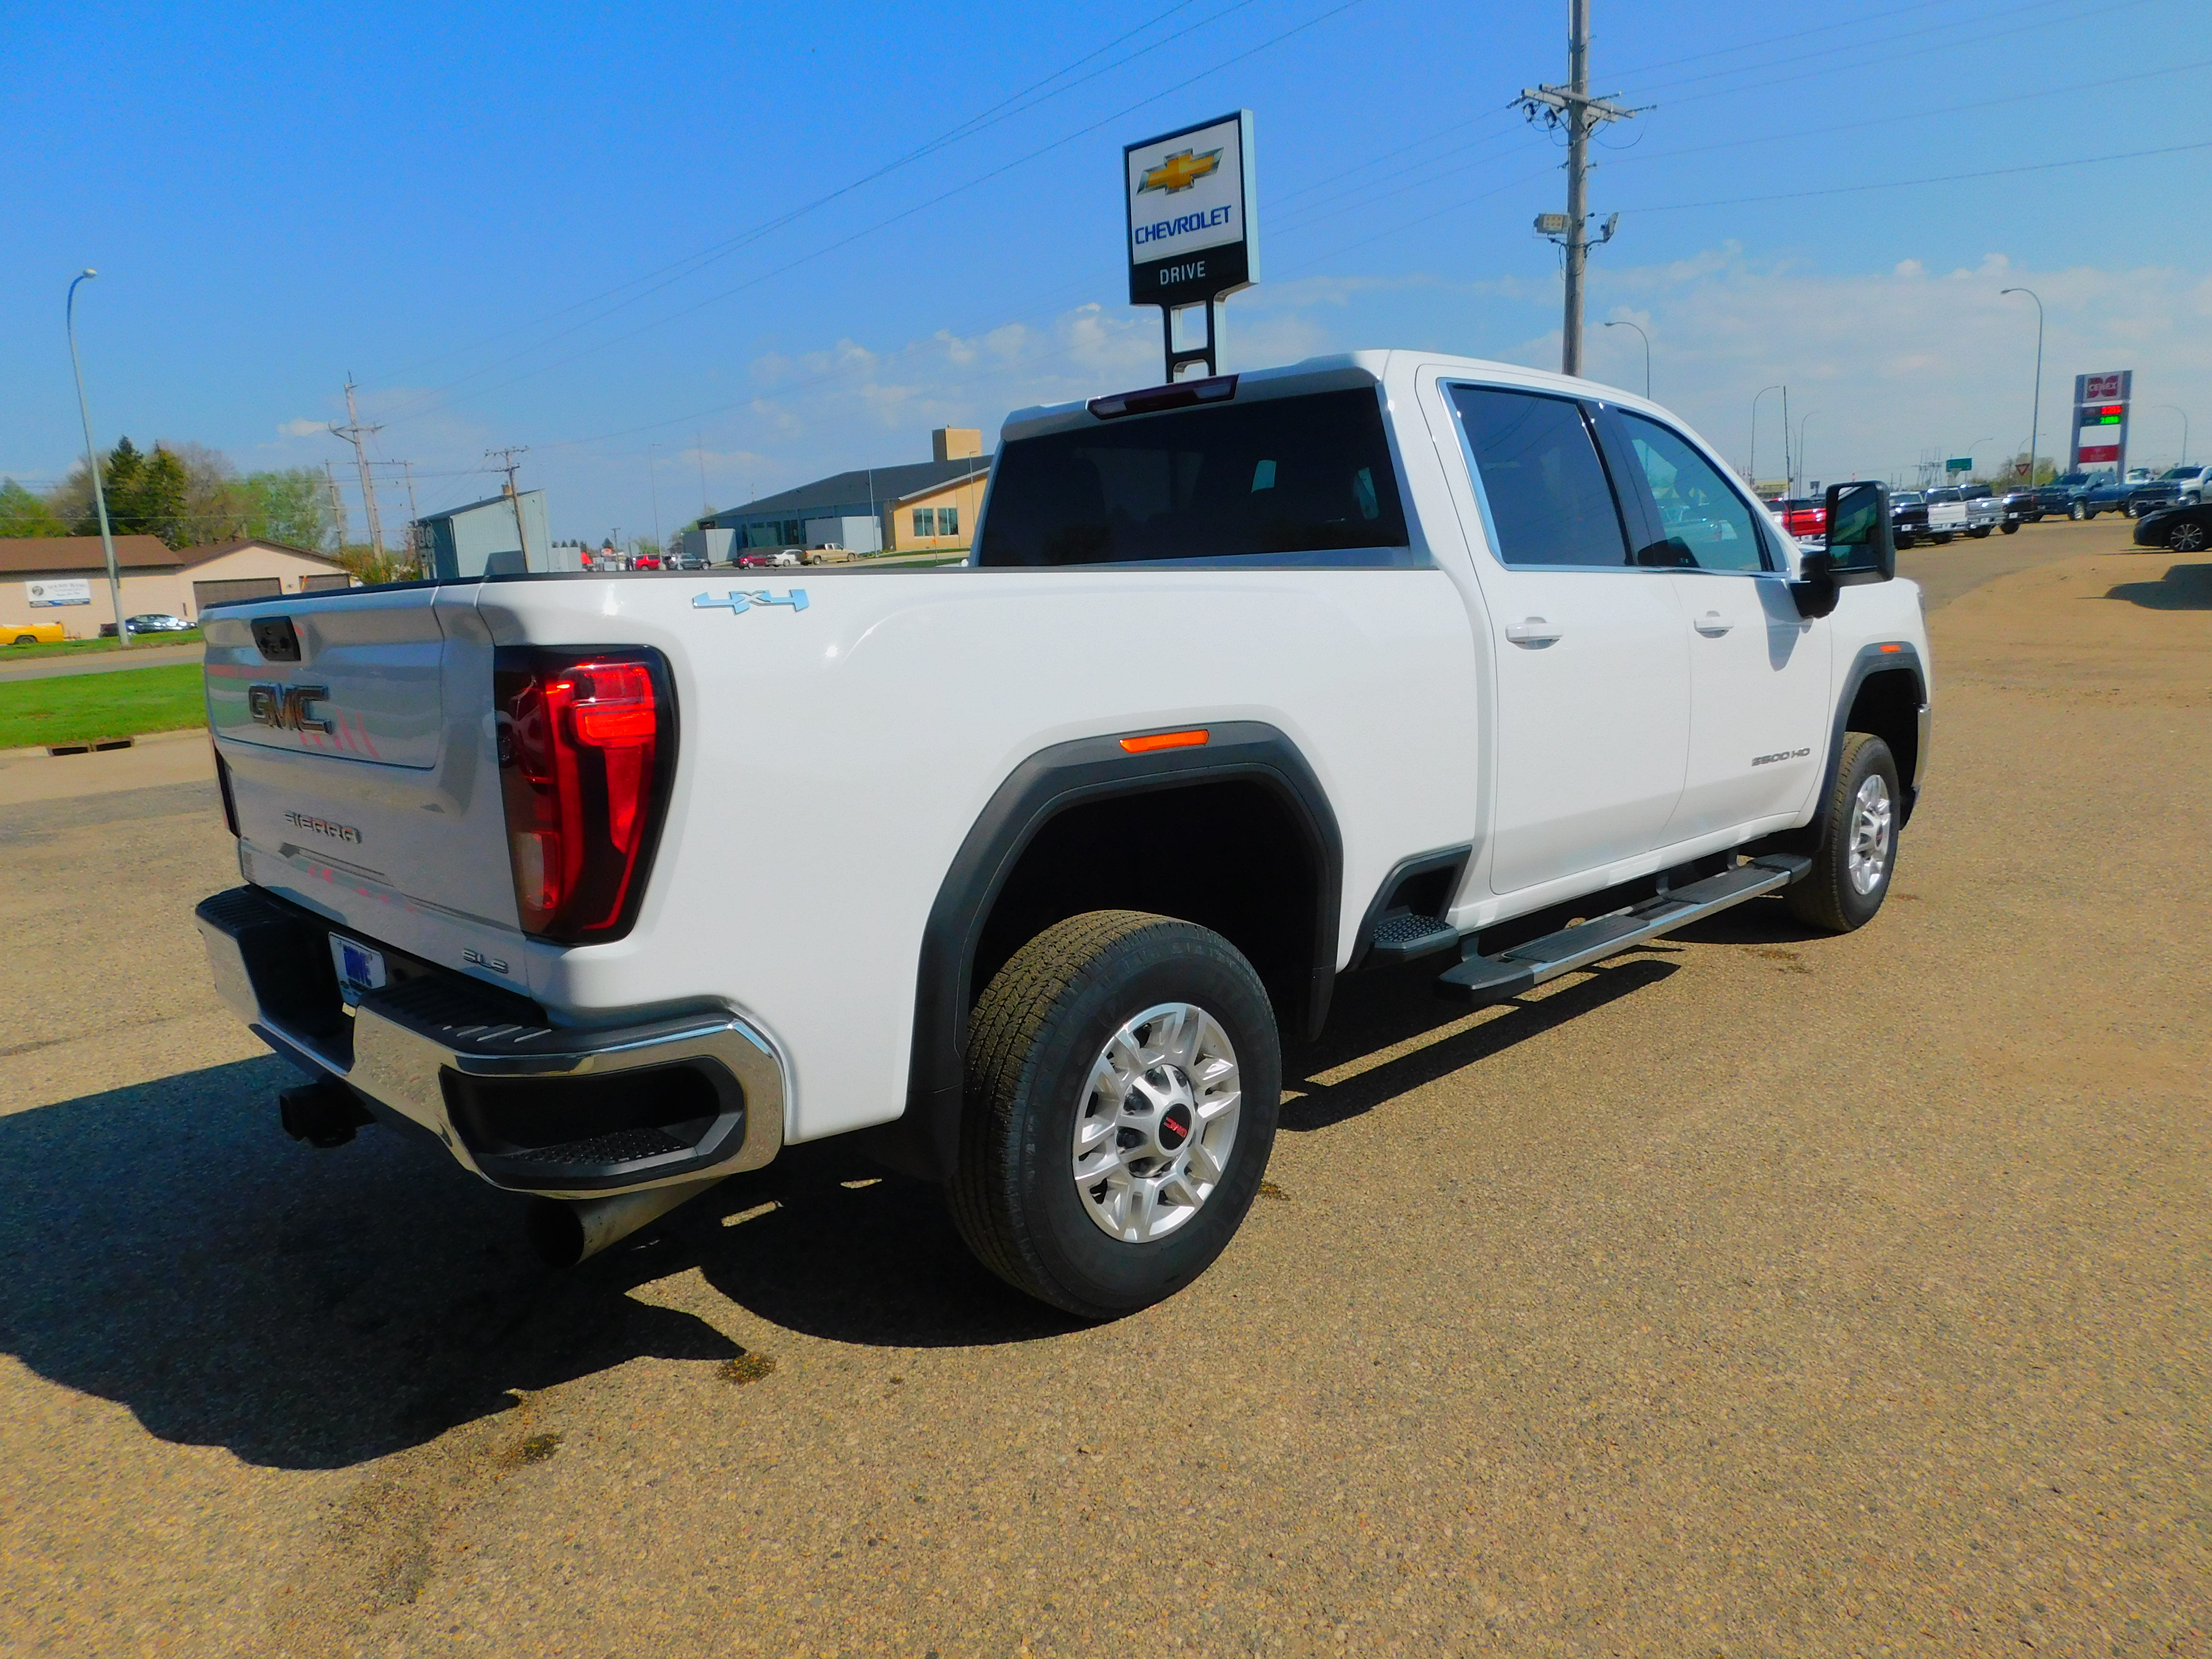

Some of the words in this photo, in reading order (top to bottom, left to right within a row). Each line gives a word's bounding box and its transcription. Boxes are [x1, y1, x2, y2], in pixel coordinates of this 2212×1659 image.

[1134, 205, 1232, 244] CHEVROLET
[1159, 260, 1206, 286] DRIVE
[248, 682, 332, 735] GMC
[283, 810, 362, 844] SIERRA
[1164, 1117, 1188, 1138] GMC
